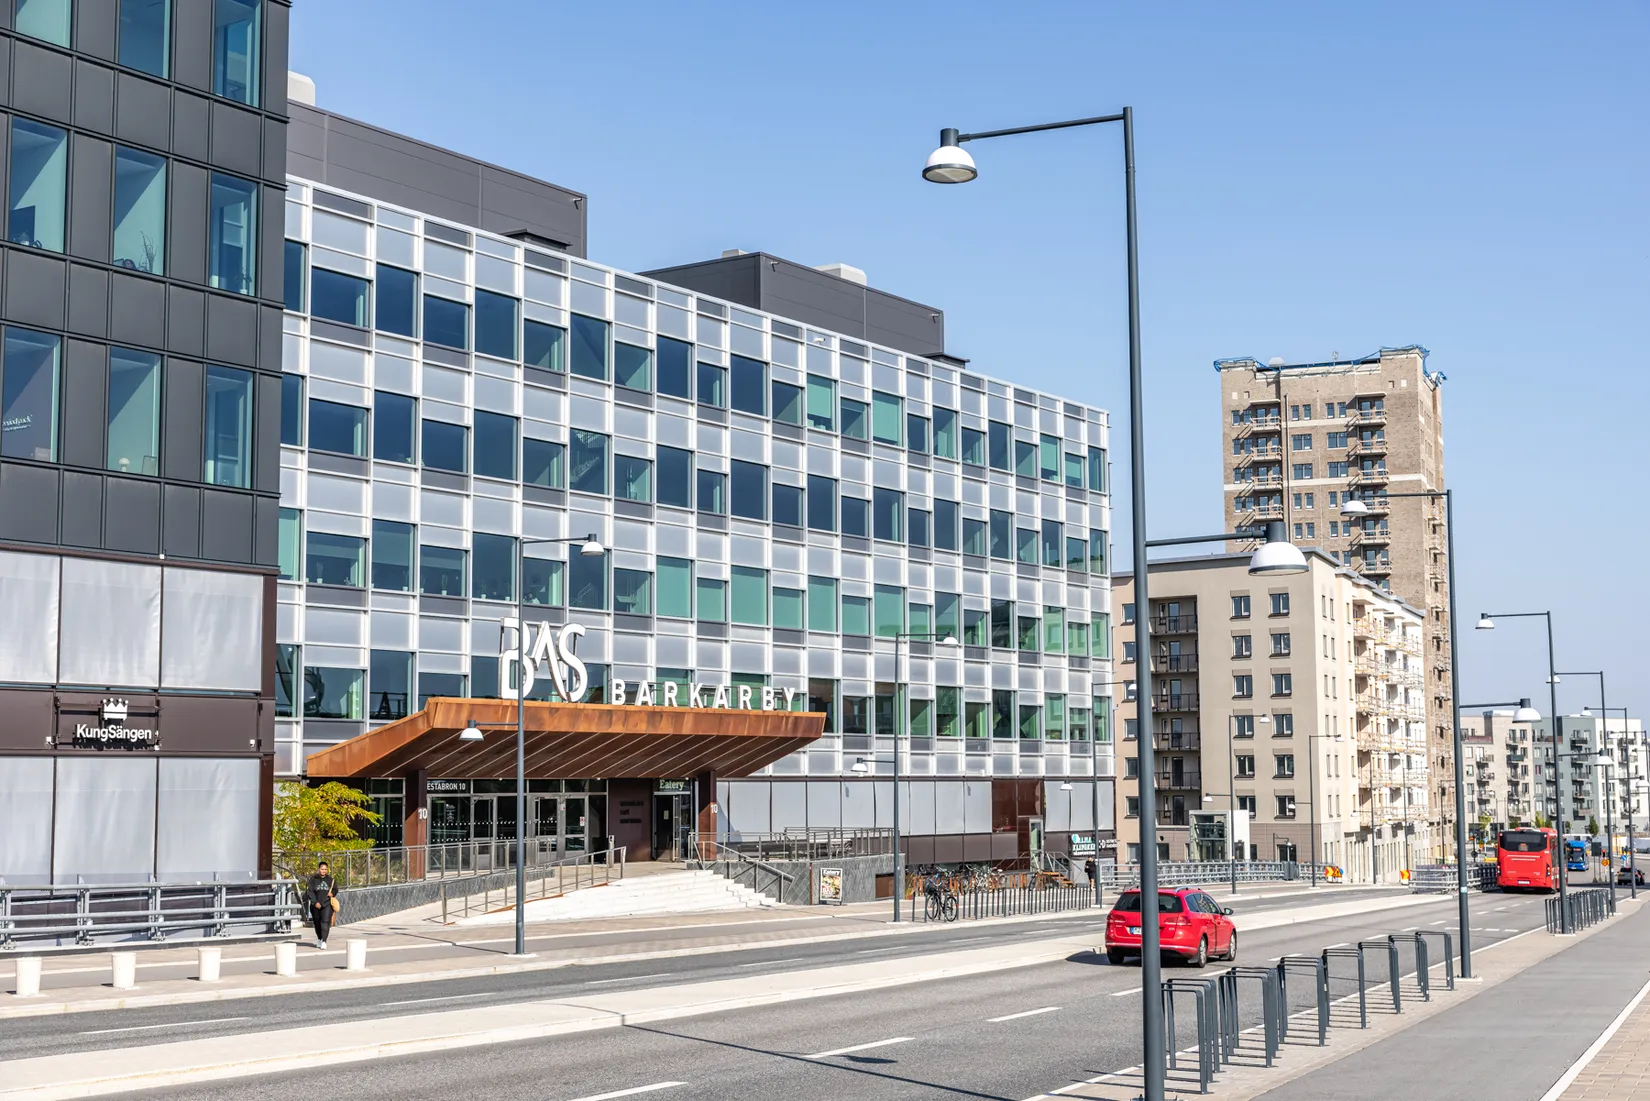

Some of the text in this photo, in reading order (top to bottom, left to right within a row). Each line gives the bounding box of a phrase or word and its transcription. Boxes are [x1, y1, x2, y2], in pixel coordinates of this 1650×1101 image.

[500, 617, 588, 702] BAS
[610, 678, 796, 712] BARKARBY
[76, 724, 152, 742] KungSängen
[458, 782, 466, 790] 10
[659, 780, 685, 790] Eatery
[418, 808, 428, 820] 10
[710, 803, 718, 814] 10
